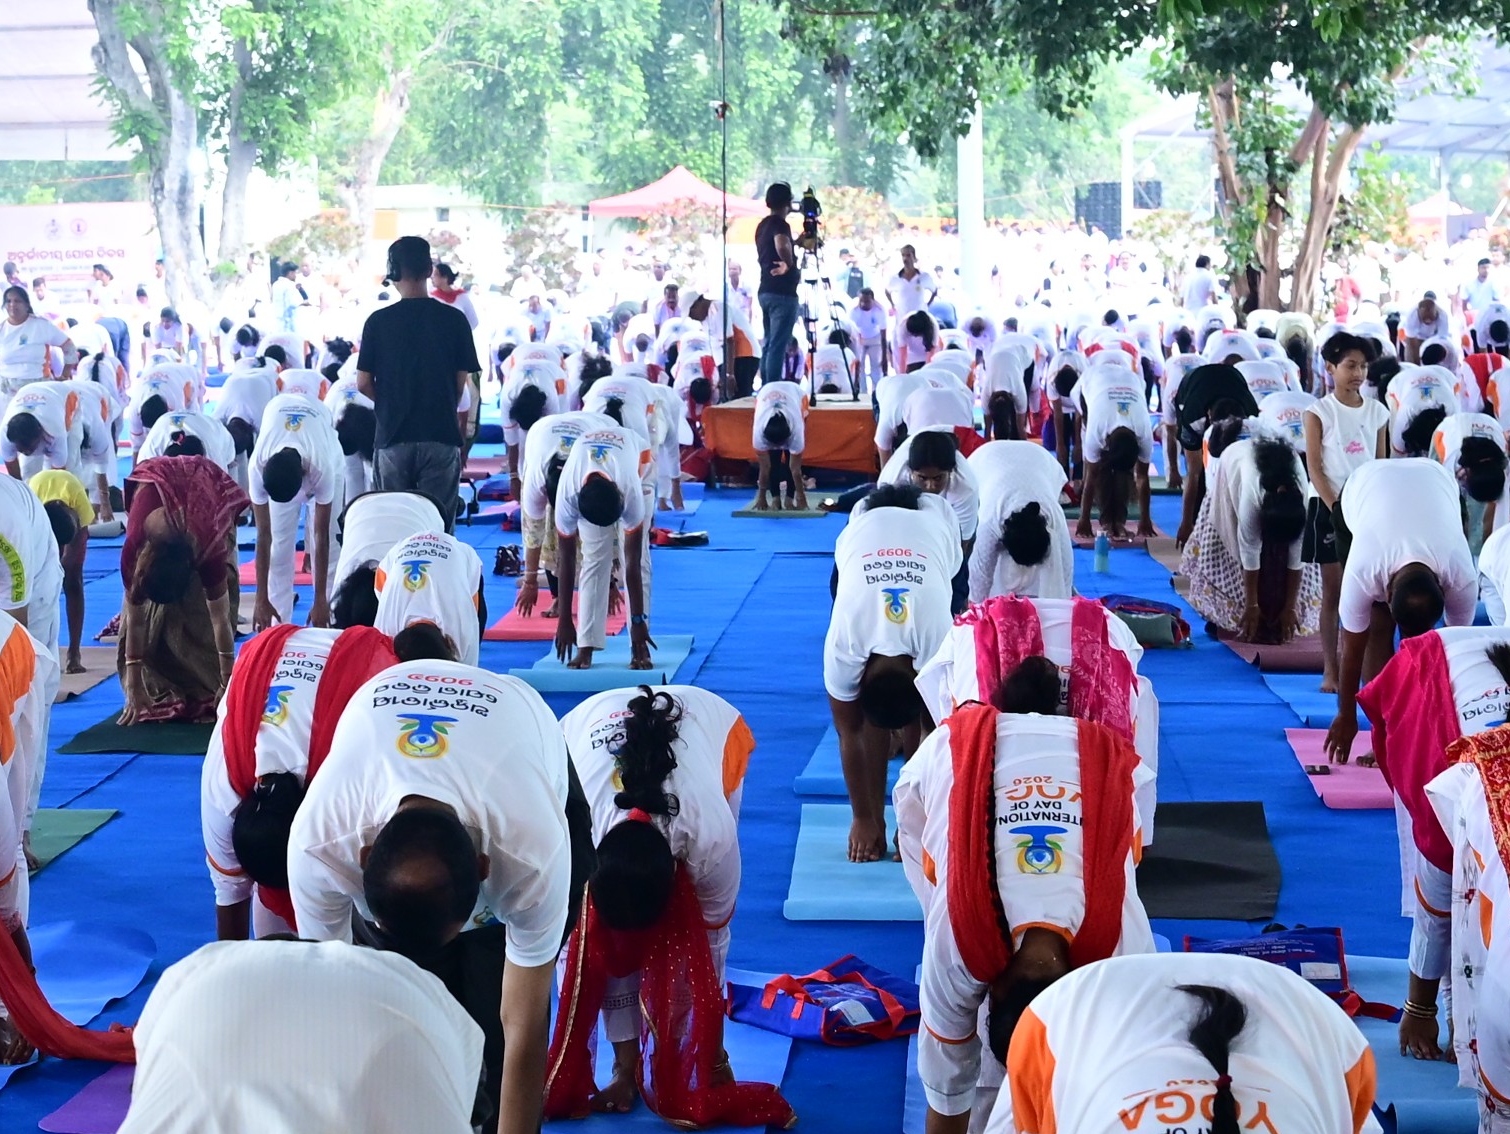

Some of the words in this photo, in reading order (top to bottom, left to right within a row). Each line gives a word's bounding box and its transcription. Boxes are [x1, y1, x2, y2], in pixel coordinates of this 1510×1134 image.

[862, 561, 891, 573] ଦିବସ
[895, 560, 927, 573] ଯୋଗ
[865, 572, 924, 586] ଅନ୍ତର୍ଜାତୀୟ
[283, 659, 324, 672] ଯୋଗ
[373, 683, 427, 696] ଦିବସ
[431, 683, 498, 705] ଯୋଗ
[372, 693, 490, 718] ଅନ୍ତର୍ଜାତୀୟ
[1009, 801, 1030, 812] OF
[1033, 801, 1063, 811] DAY
